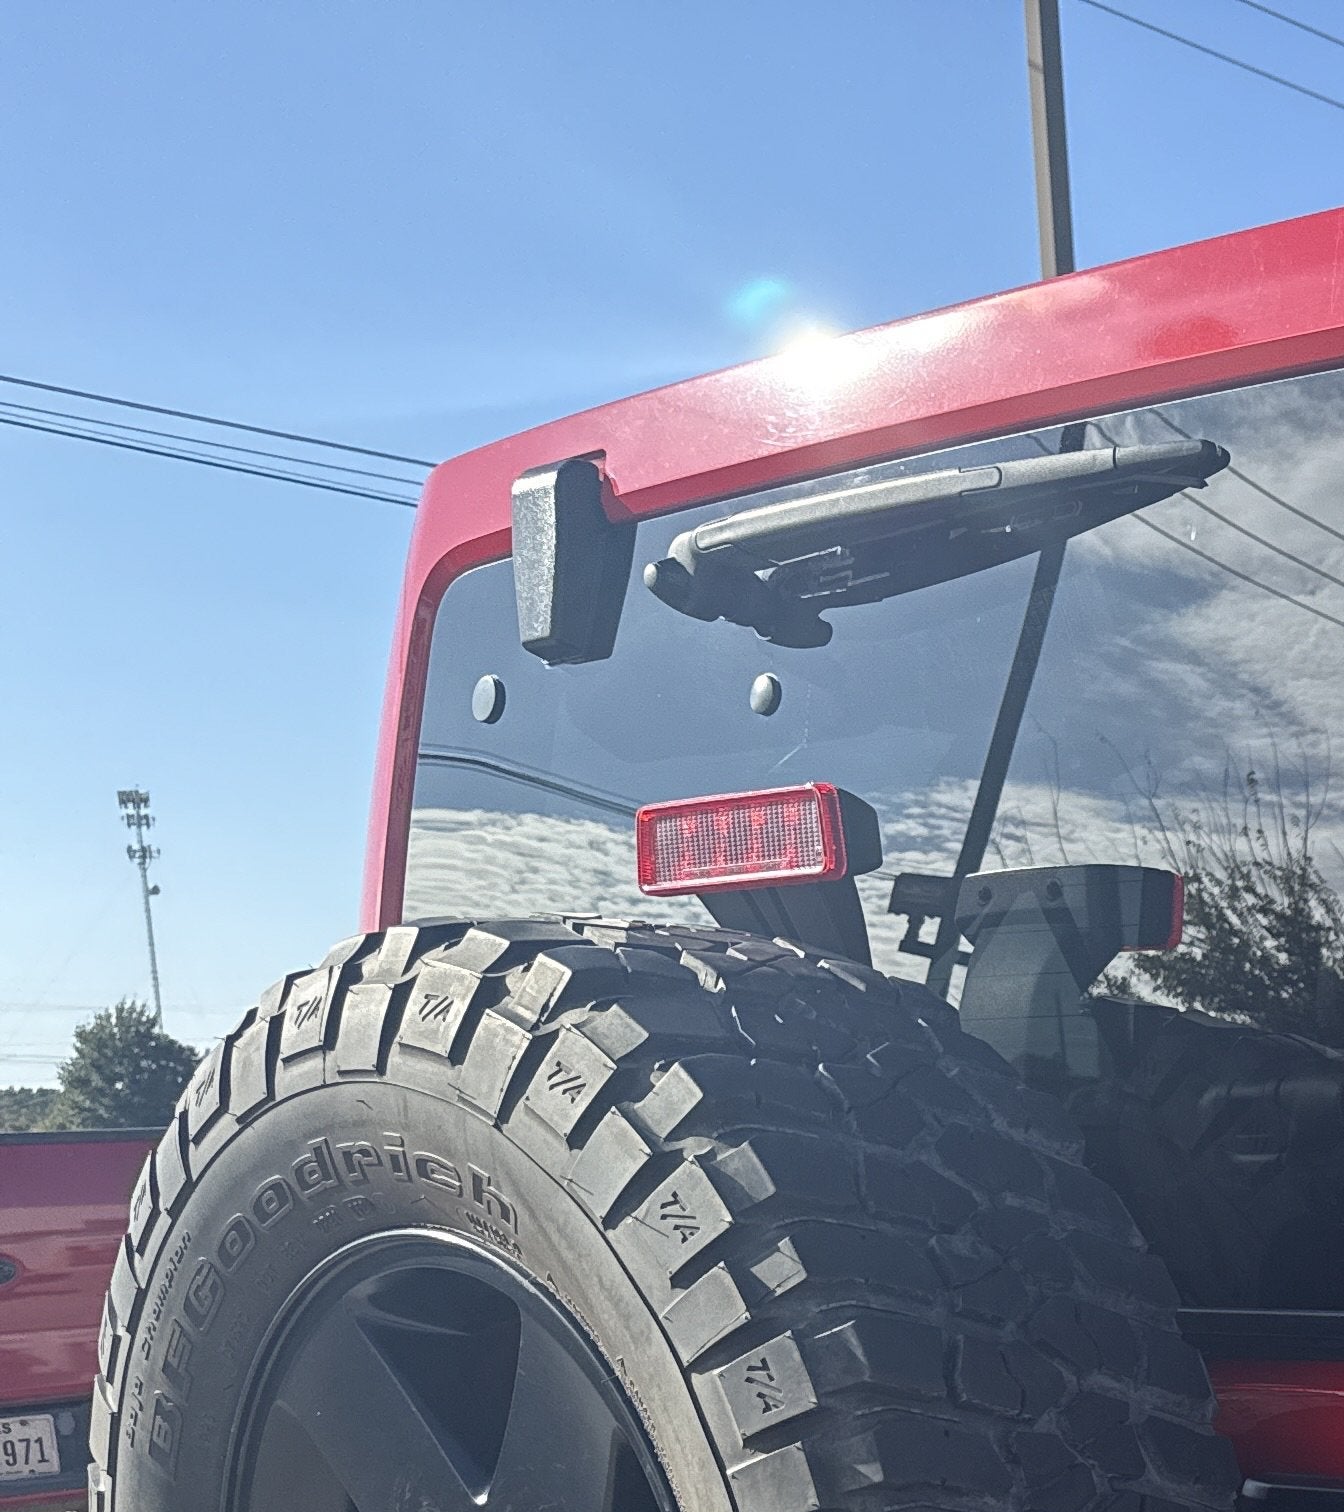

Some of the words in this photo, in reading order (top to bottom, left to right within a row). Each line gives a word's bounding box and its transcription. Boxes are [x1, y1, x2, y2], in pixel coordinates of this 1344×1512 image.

[546, 1059, 588, 1105] T/A
[660, 1190, 701, 1244] T/A
[148, 1132, 519, 1482] BFGoodrich
[744, 1356, 786, 1415] T/A
